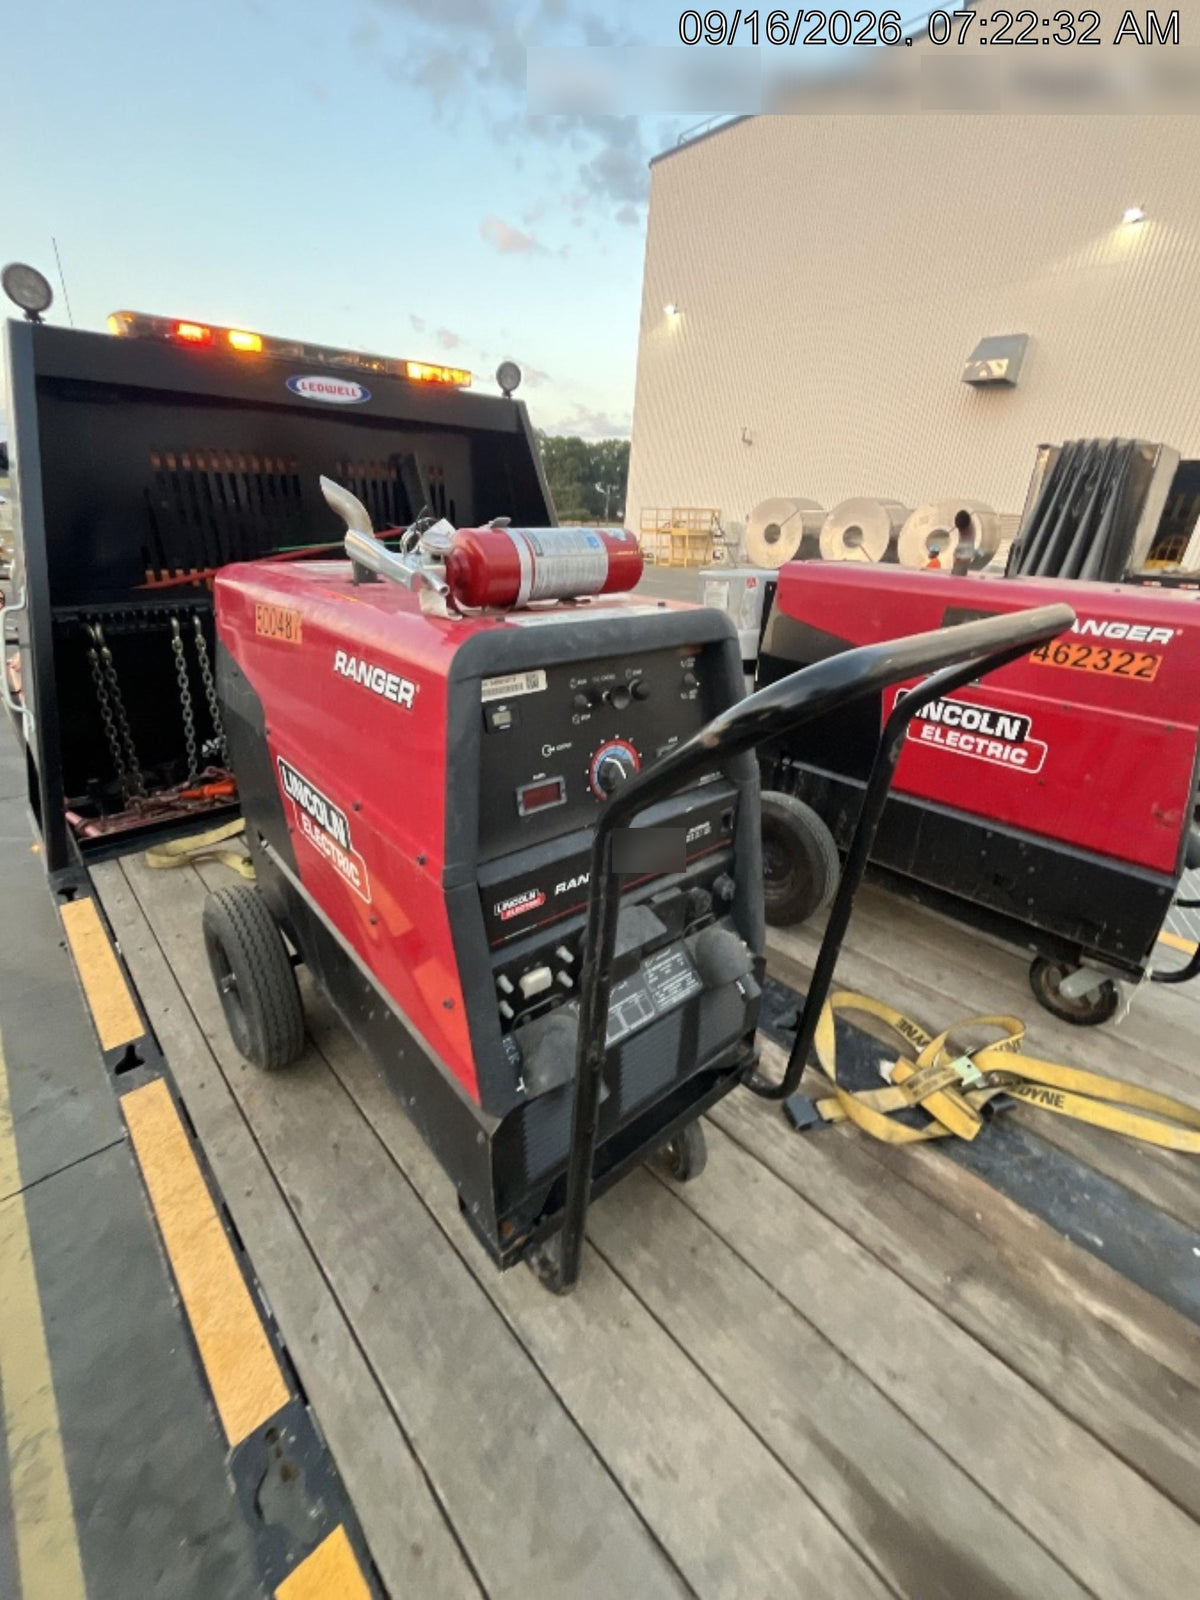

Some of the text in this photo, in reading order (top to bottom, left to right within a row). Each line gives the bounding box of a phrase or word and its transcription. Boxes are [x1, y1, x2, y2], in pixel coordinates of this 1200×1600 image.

[301, 381, 358, 397] LEDWELL
[334, 650, 415, 709] RANGER
[1033, 643, 1160, 678] 462322
[915, 700, 1022, 741] INCOLN
[921, 724, 1029, 765] ELECTRIC
[282, 765, 348, 849] LINCOLN
[300, 812, 362, 887] ELECTRIC
[554, 872, 590, 896] RAN
